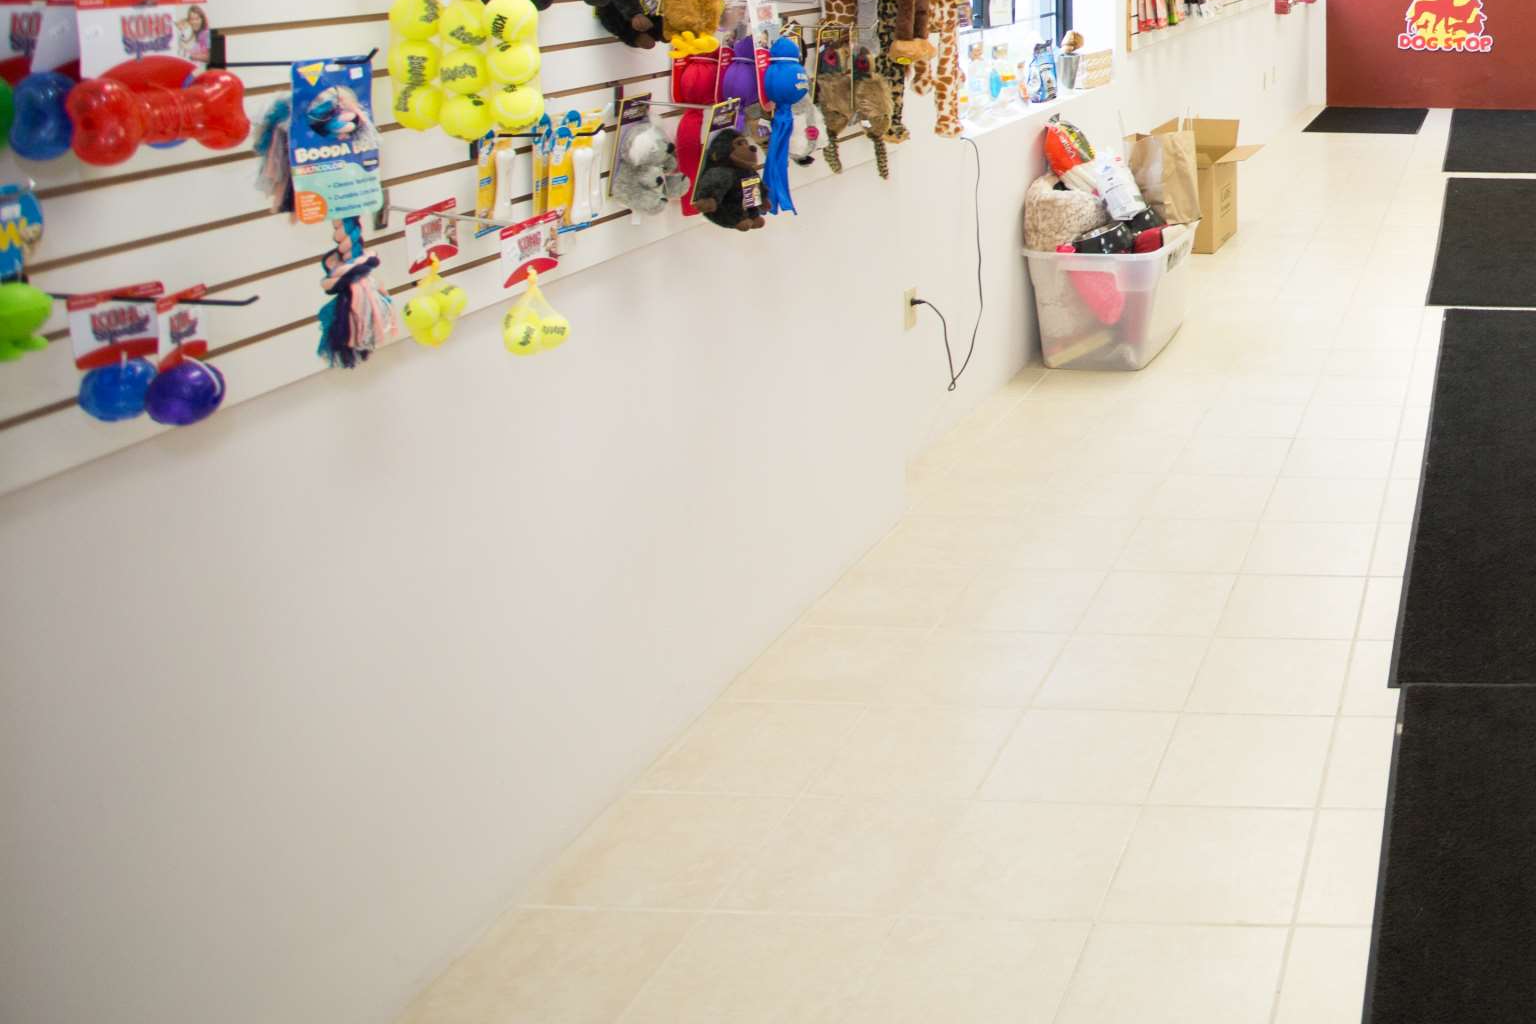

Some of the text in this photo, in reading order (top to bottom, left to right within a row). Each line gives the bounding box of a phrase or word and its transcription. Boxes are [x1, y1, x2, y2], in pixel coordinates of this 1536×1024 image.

[121, 13, 173, 41] KONG
[1399, 35, 1492, 51] DOG STOP
[295, 143, 350, 164] BOODA
